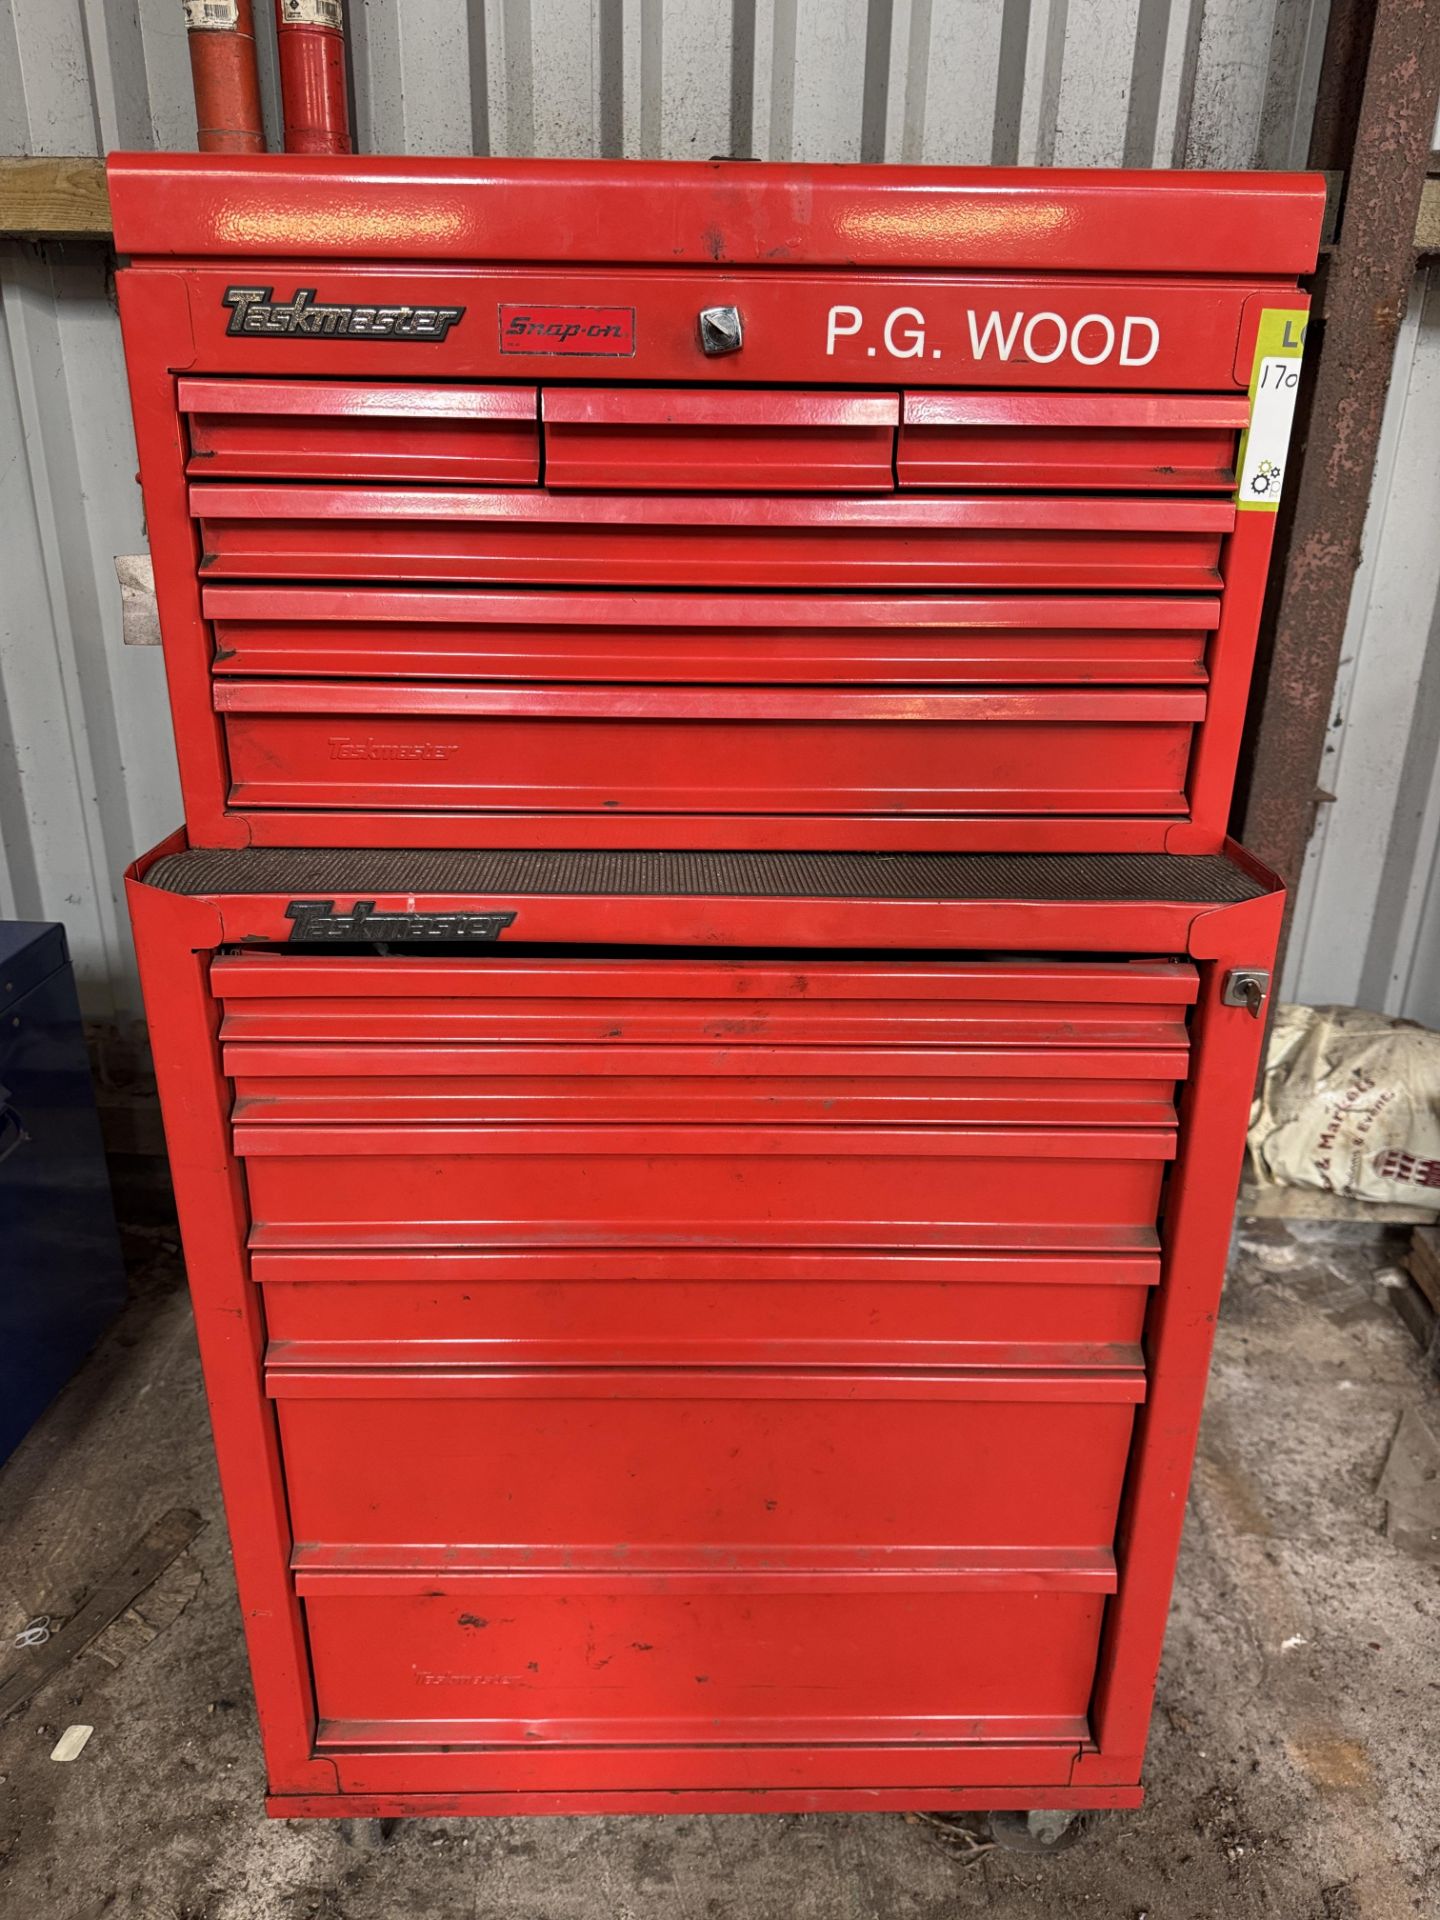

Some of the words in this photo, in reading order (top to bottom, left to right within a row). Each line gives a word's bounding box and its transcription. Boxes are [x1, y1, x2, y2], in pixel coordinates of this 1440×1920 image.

[226, 288, 462, 338] Taskmaster
[505, 316, 624, 342] Snap-on
[826, 305, 942, 359] P.G.
[966, 310, 1160, 366] WOOD
[1261, 364, 1299, 389] 170
[328, 737, 459, 761] Taskmaster
[287, 901, 517, 941] Taskmaster
